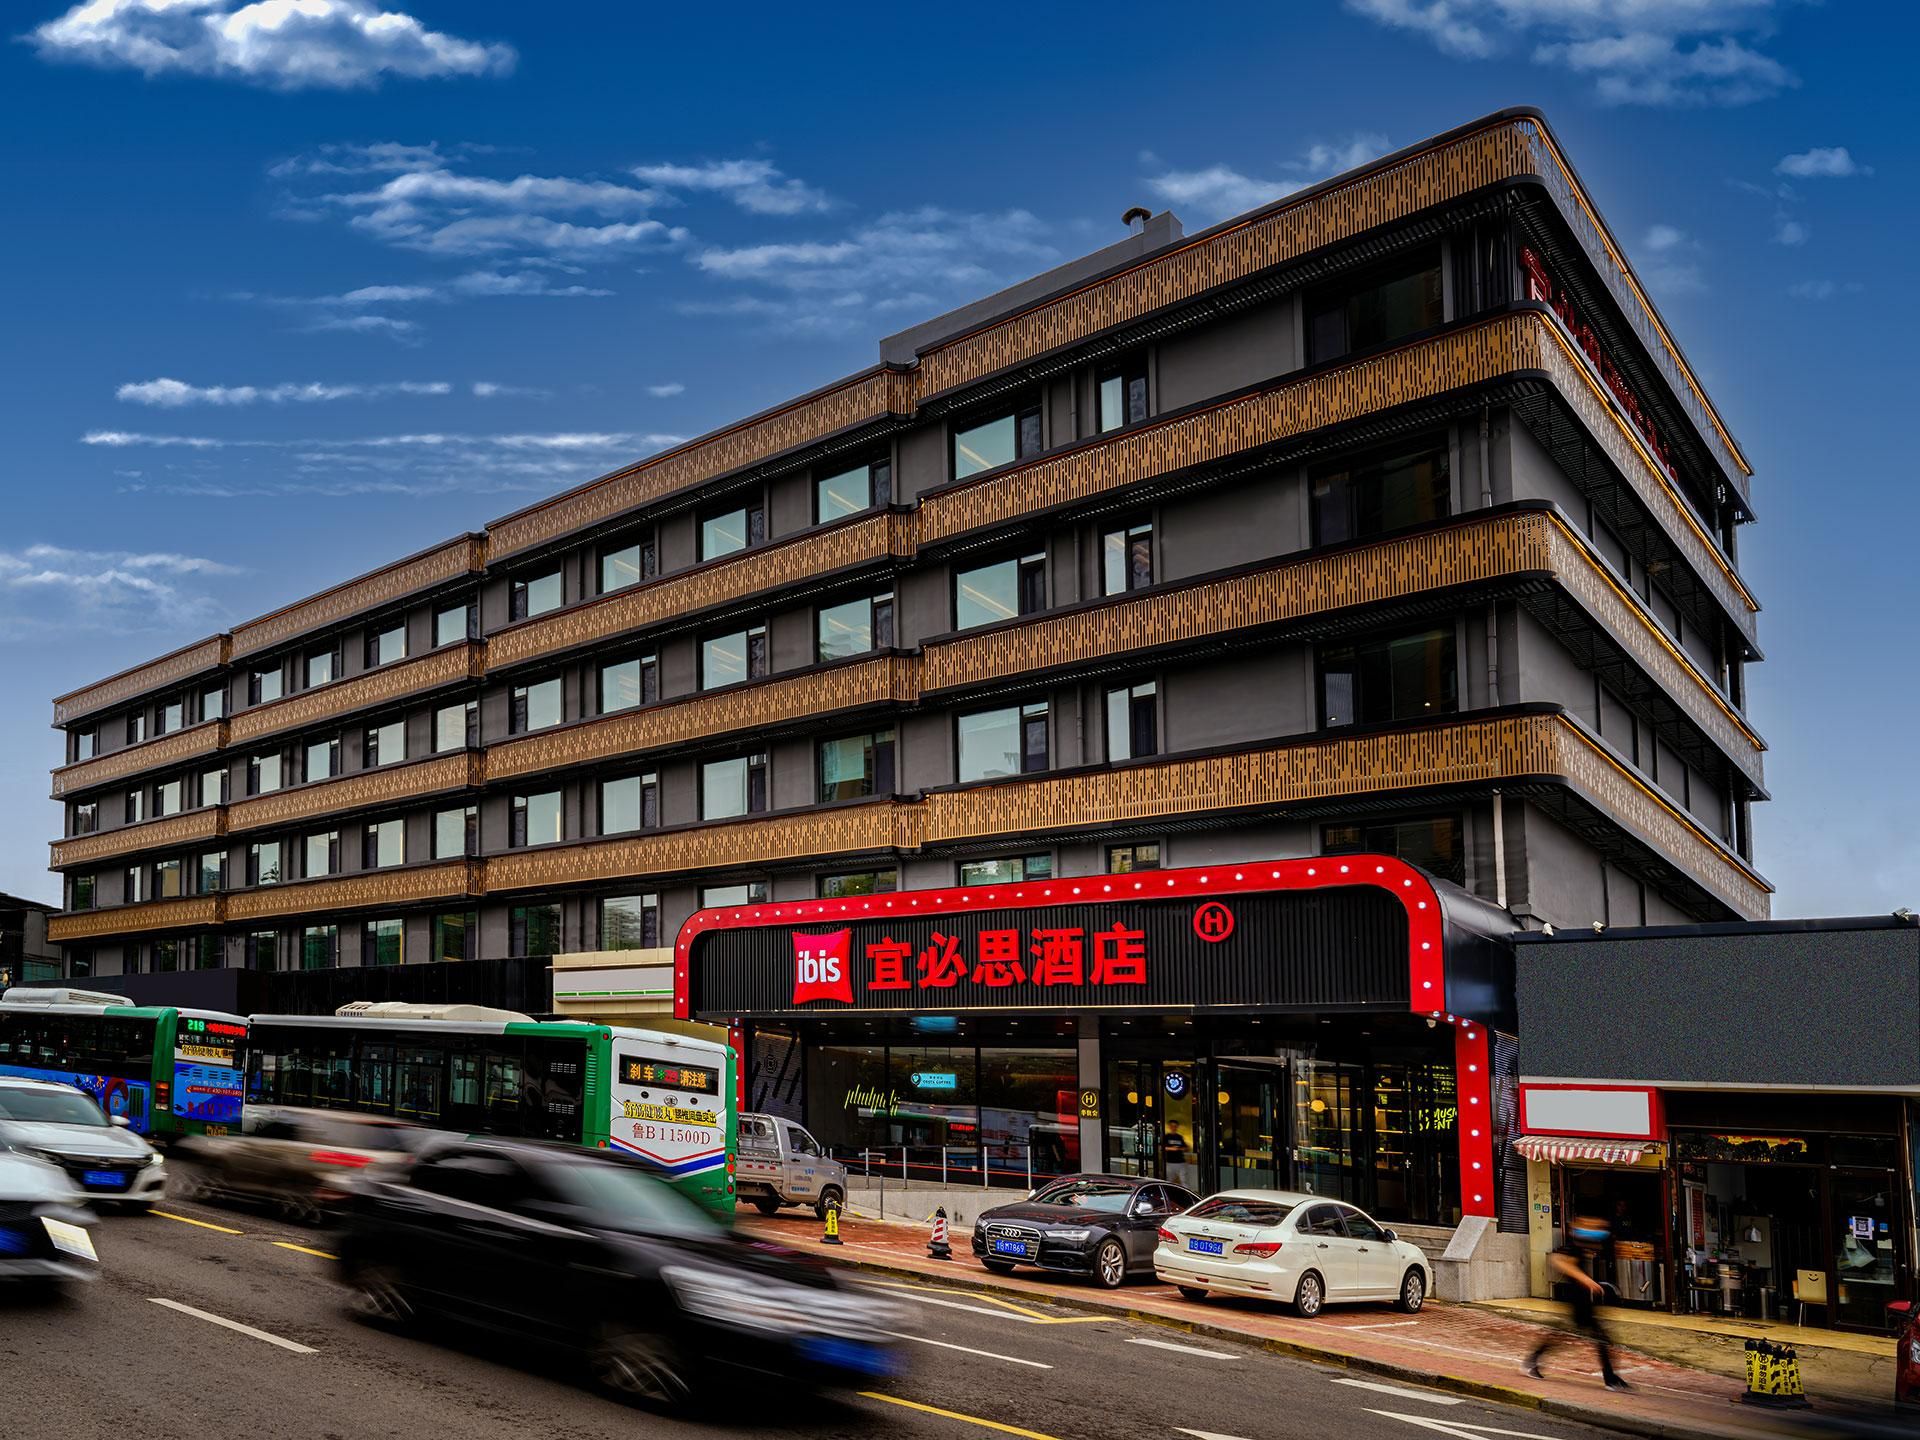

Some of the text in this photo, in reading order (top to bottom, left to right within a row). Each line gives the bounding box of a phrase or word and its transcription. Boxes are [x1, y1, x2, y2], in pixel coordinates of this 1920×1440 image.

[798, 950, 841, 984] ibis
[865, 920, 1147, 990] 宜必思酒店
[187, 1018, 205, 1032] 219
[629, 1063, 654, 1081] 刹车
[679, 1070, 707, 1089] 请注意
[632, 1122, 711, 1145] 鲁B11500D
